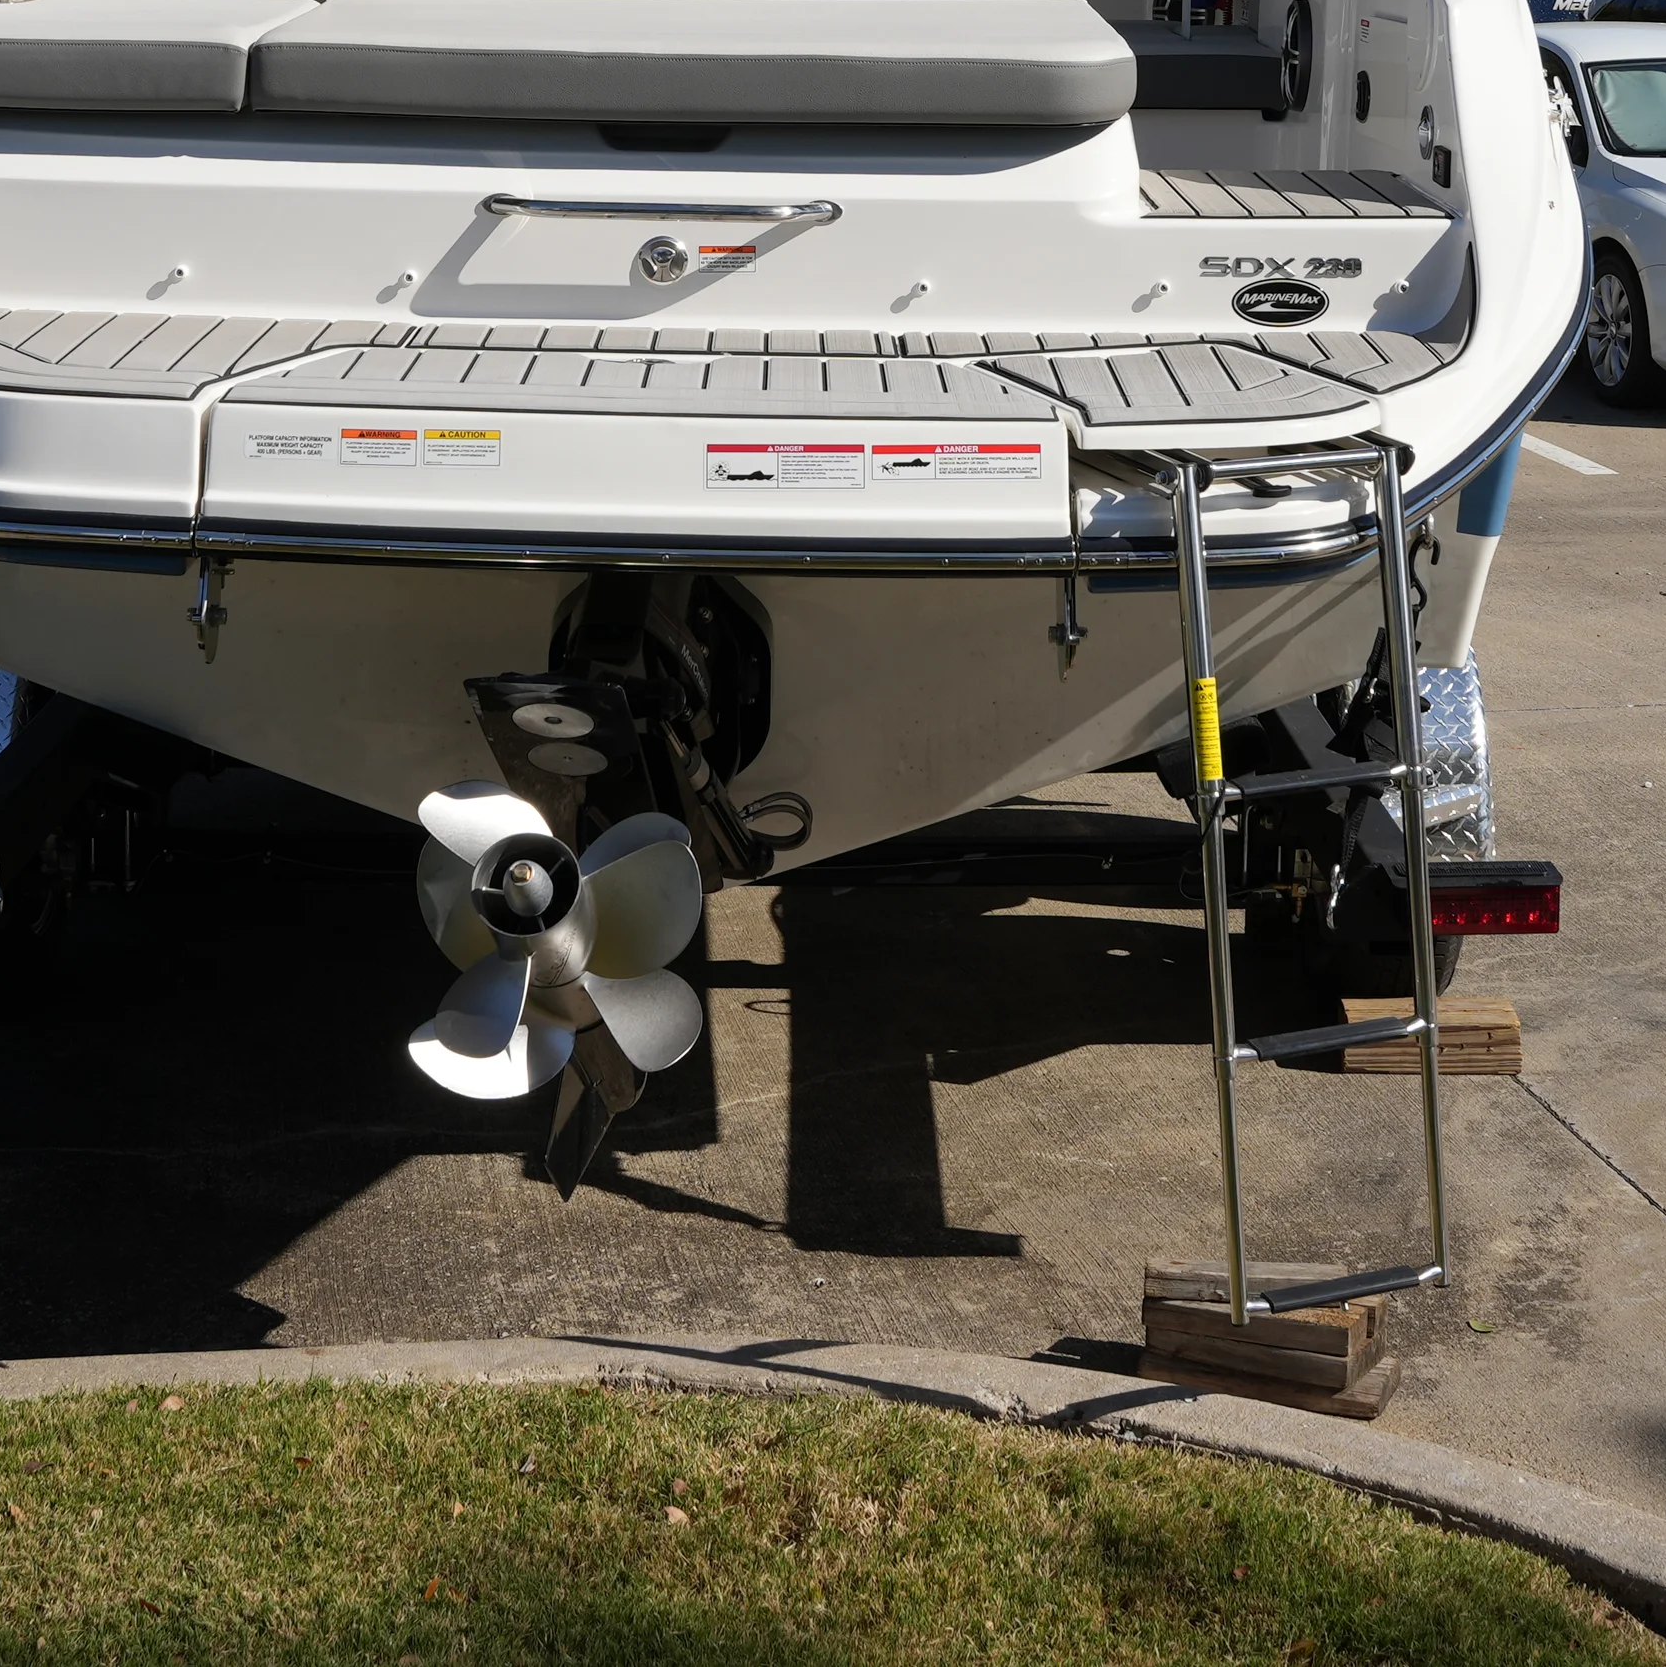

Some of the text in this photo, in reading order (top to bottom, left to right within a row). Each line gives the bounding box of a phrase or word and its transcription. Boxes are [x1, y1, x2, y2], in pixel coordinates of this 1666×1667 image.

[1199, 256, 1362, 279] SDX 230
[1239, 293, 1321, 304] MARINEMAX
